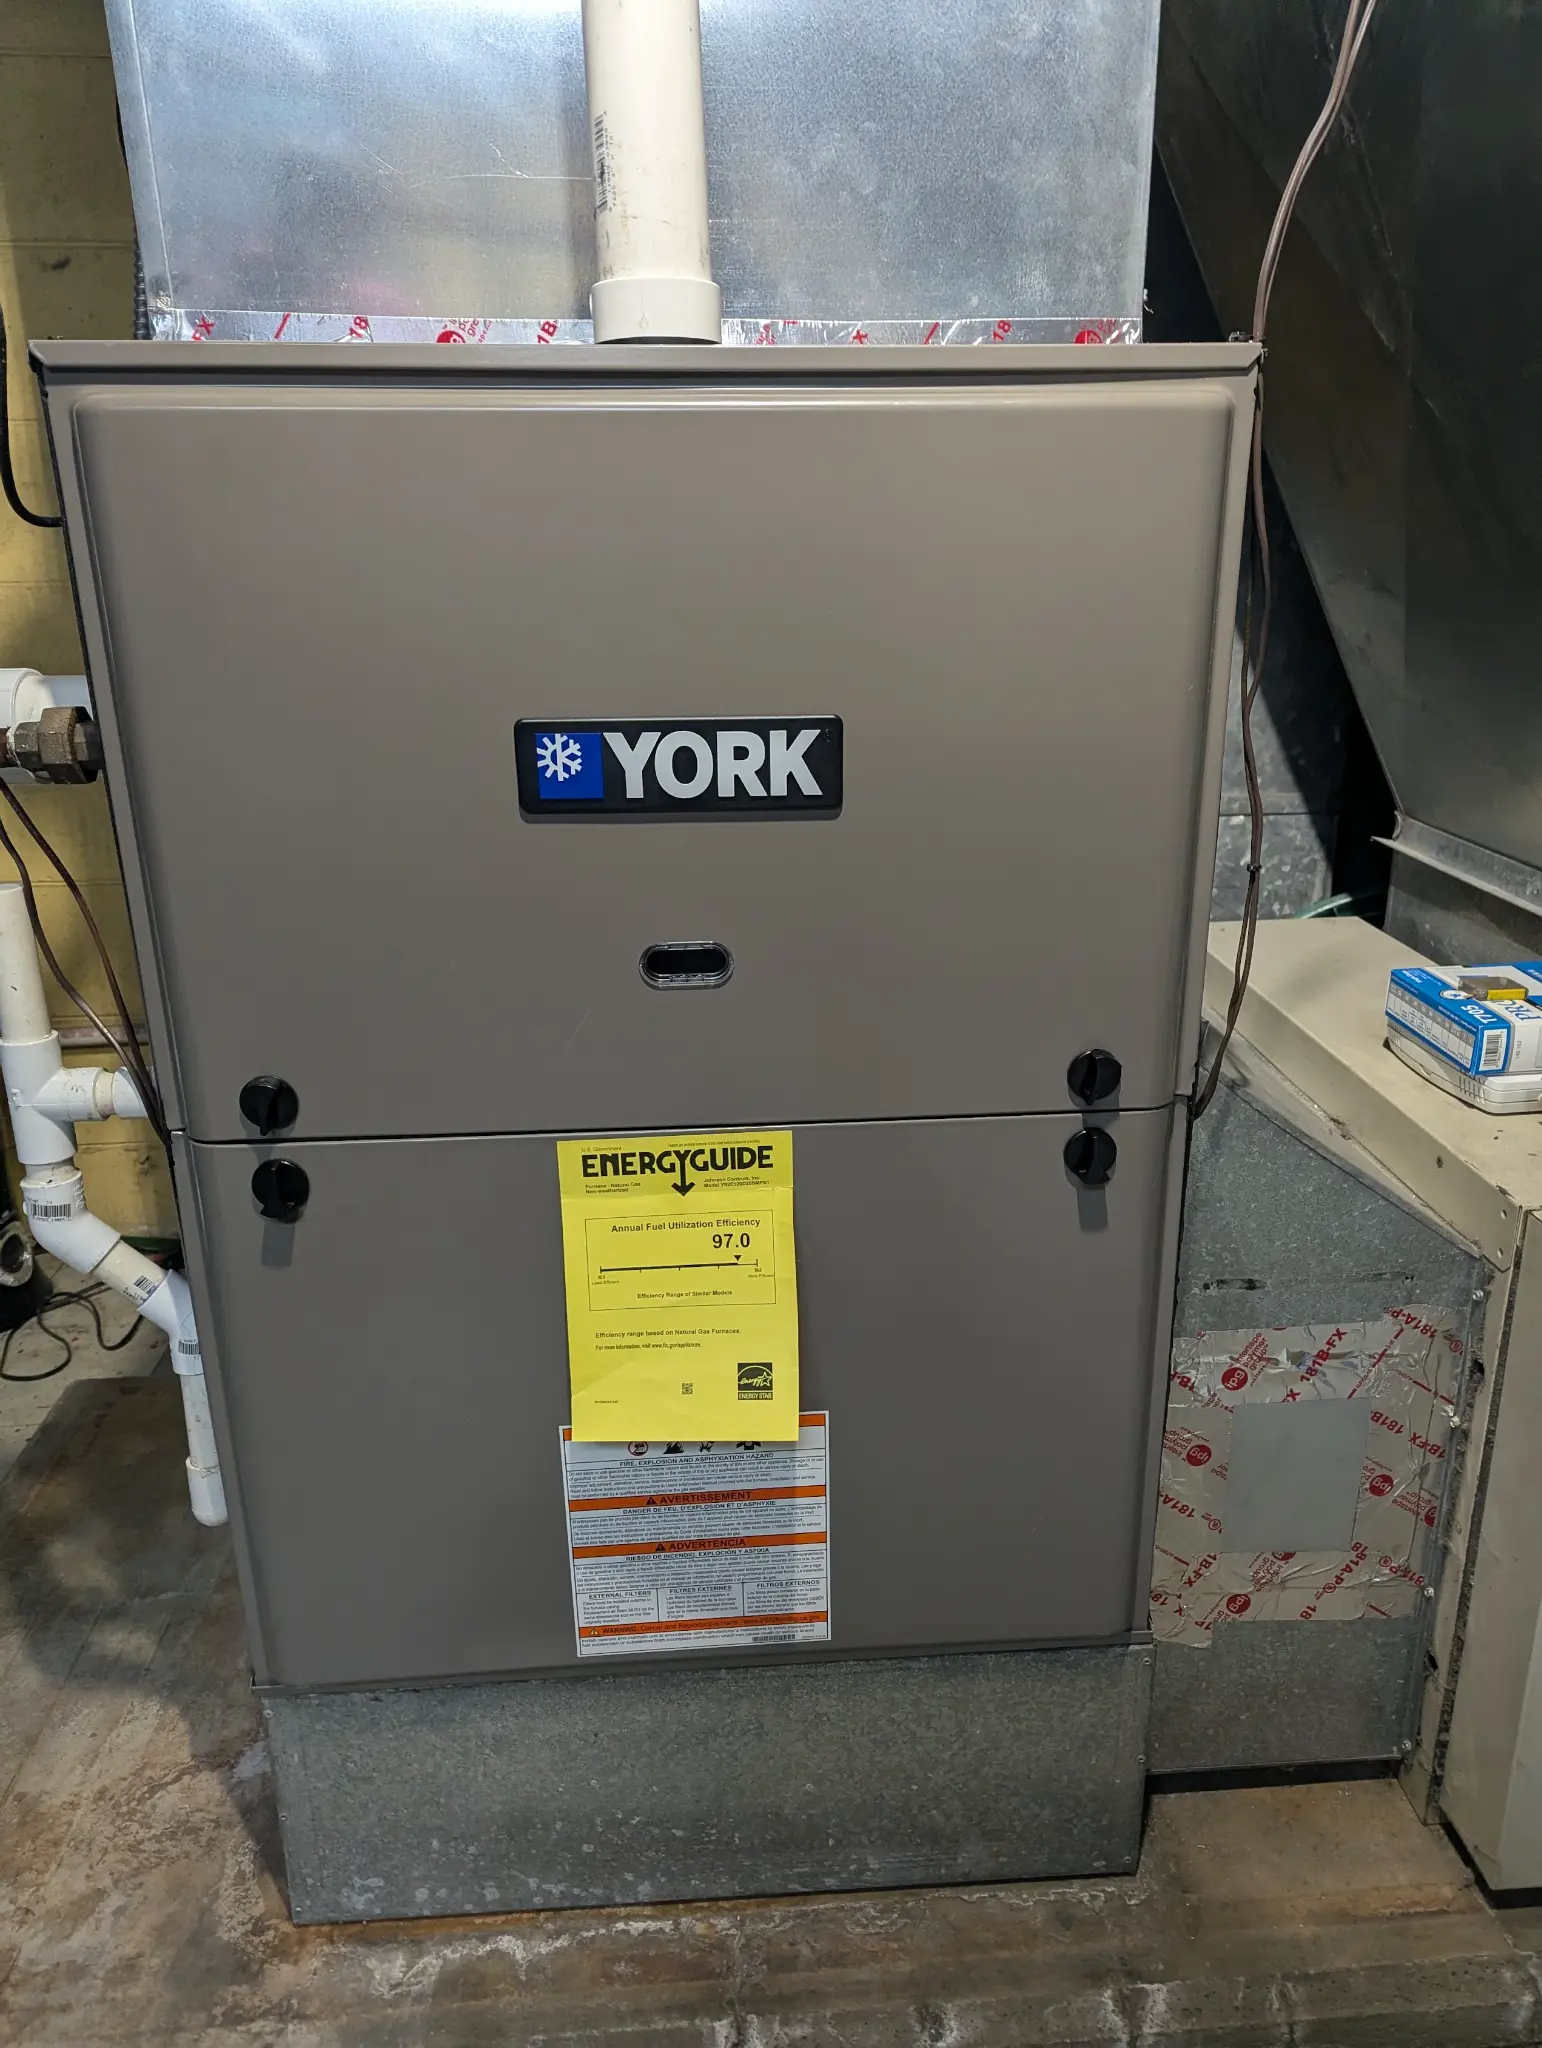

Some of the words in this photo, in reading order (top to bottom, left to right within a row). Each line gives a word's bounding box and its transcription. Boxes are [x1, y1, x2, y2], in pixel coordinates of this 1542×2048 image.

[603, 730, 823, 799] YORK
[1461, 1004, 1497, 1024] T705
[581, 1144, 774, 1178] ENERGYGUIDE
[611, 1223, 644, 1234] Annual
[646, 1222, 666, 1231] Fuel
[668, 1219, 714, 1231] Utilization
[716, 1217, 761, 1229] Efficiency
[711, 1232, 750, 1249] 97.0
[637, 1292, 665, 1300] Efficiency
[595, 1331, 626, 1340] Efficiency
[626, 1331, 645, 1339] range
[646, 1329, 664, 1337] based
[711, 1327, 742, 1335] Furnaces.
[615, 1343, 642, 1351] information,
[1233, 1334, 1262, 1364] intertape
[1240, 1335, 1267, 1368] polymer
[1300, 1329, 1346, 1381] 181B-FX
[1225, 1367, 1245, 1391] ipg
[1410, 1433, 1444, 1458] 1B-FX
[637, 1457, 677, 1465] EXPLOSION
[694, 1454, 744, 1462] ASPHYXIATION
[1189, 1446, 1208, 1465] ipg
[1372, 1478, 1391, 1495] ipg
[658, 1490, 752, 1504] AVERTISSEMENT
[667, 1538, 746, 1550] ADVERTENCIA
[1183, 1553, 1218, 1588] 1B-FX
[1229, 1593, 1248, 1615] ipg
[1299, 1603, 1317, 1620] 18
[639, 1623, 664, 1631] Cancer
[678, 1620, 719, 1629] Reproductive
